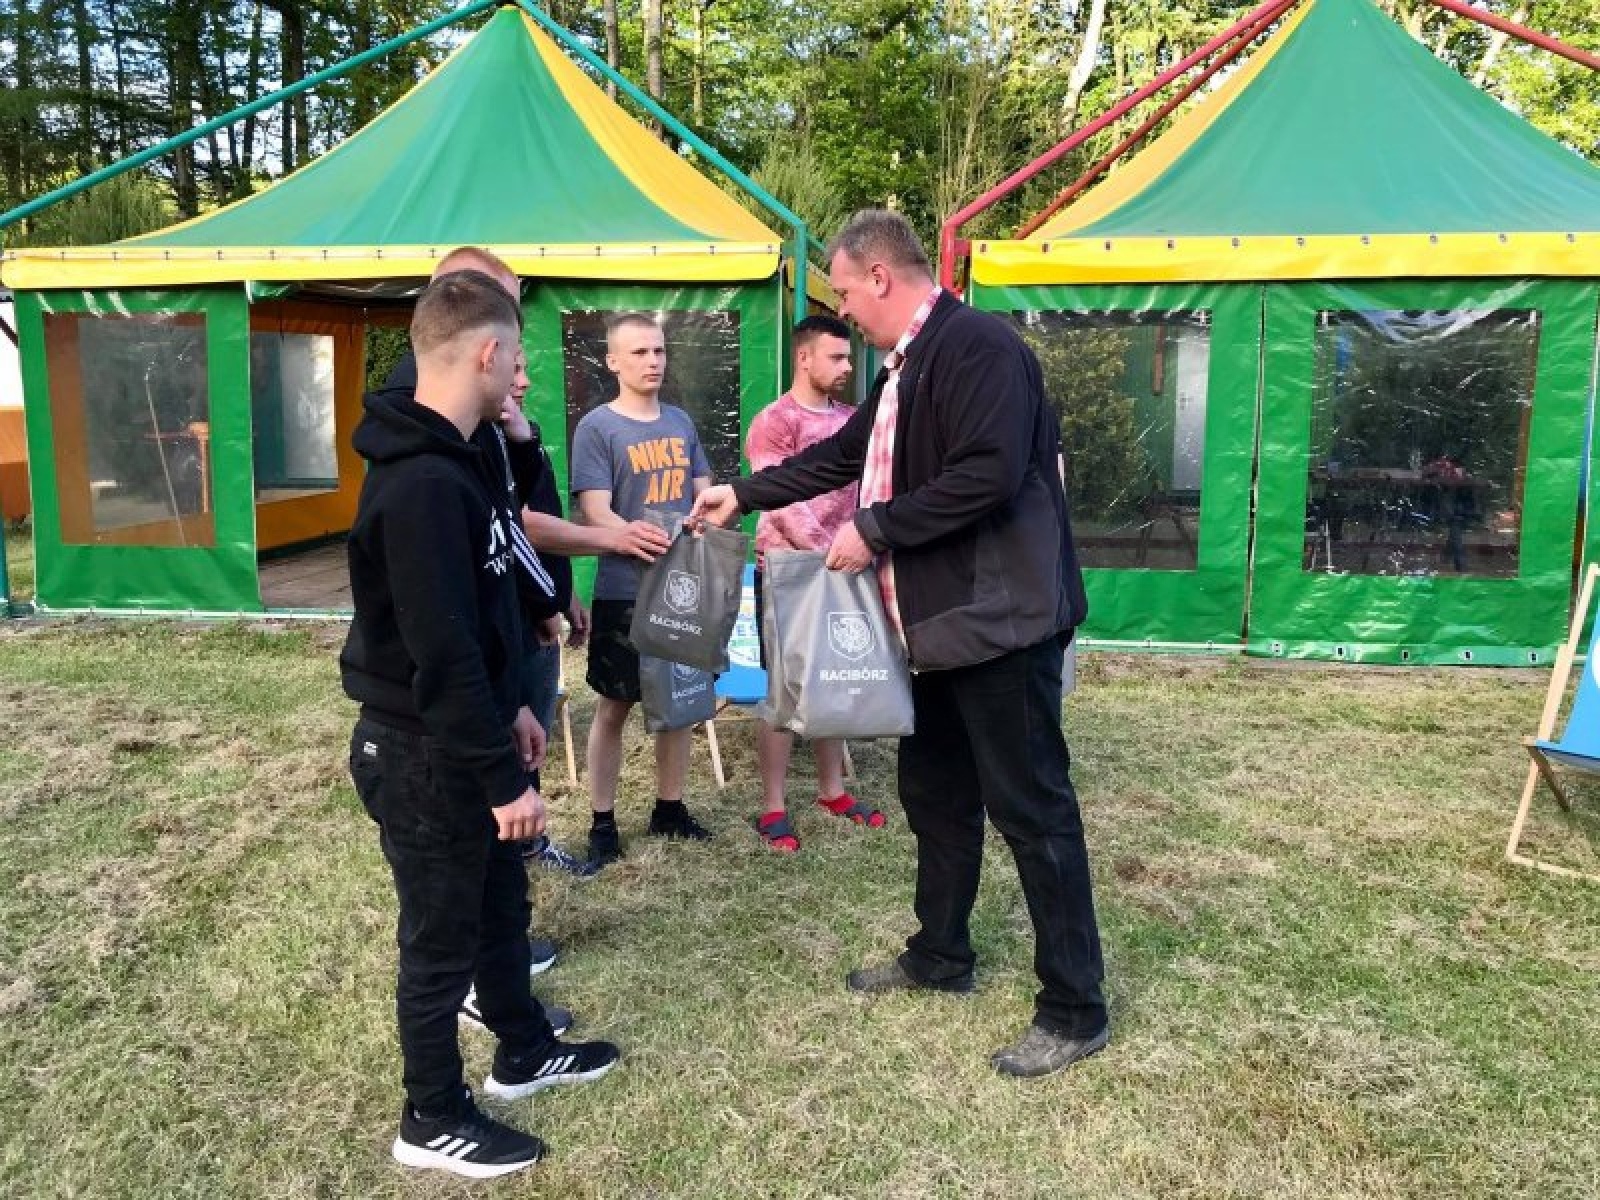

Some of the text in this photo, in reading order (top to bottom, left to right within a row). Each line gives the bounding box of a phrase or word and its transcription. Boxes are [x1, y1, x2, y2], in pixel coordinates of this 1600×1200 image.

[627, 438, 690, 474] NIKE
[644, 470, 684, 504] AIR
[819, 666, 889, 681] RACIBÓRZ
